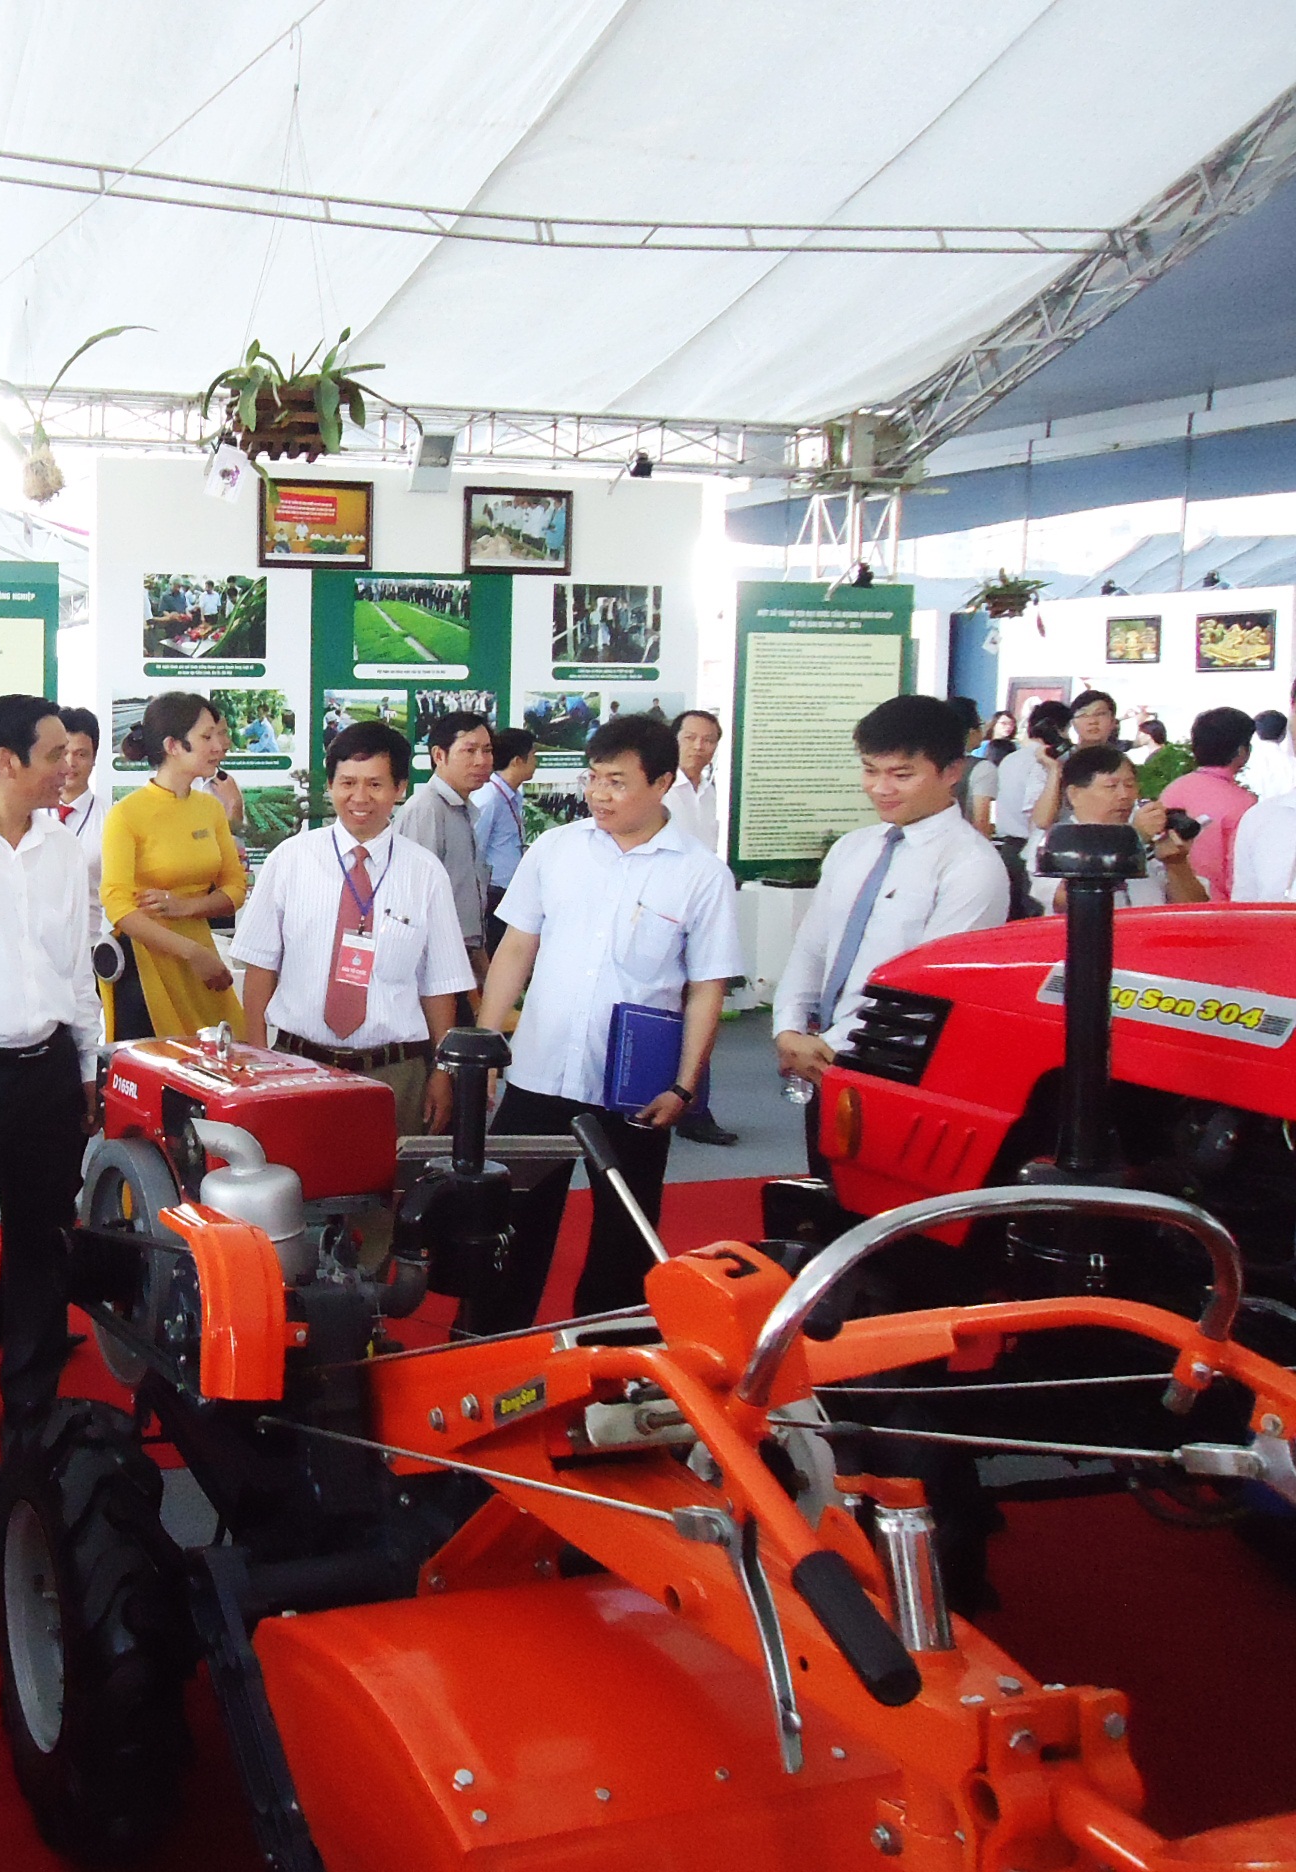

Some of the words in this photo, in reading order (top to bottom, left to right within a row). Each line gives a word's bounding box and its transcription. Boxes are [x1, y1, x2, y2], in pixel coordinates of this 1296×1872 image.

[1137, 988, 1196, 1018] Sen
[1197, 998, 1265, 1030] 304
[112, 1073, 138, 1100] D165RL
